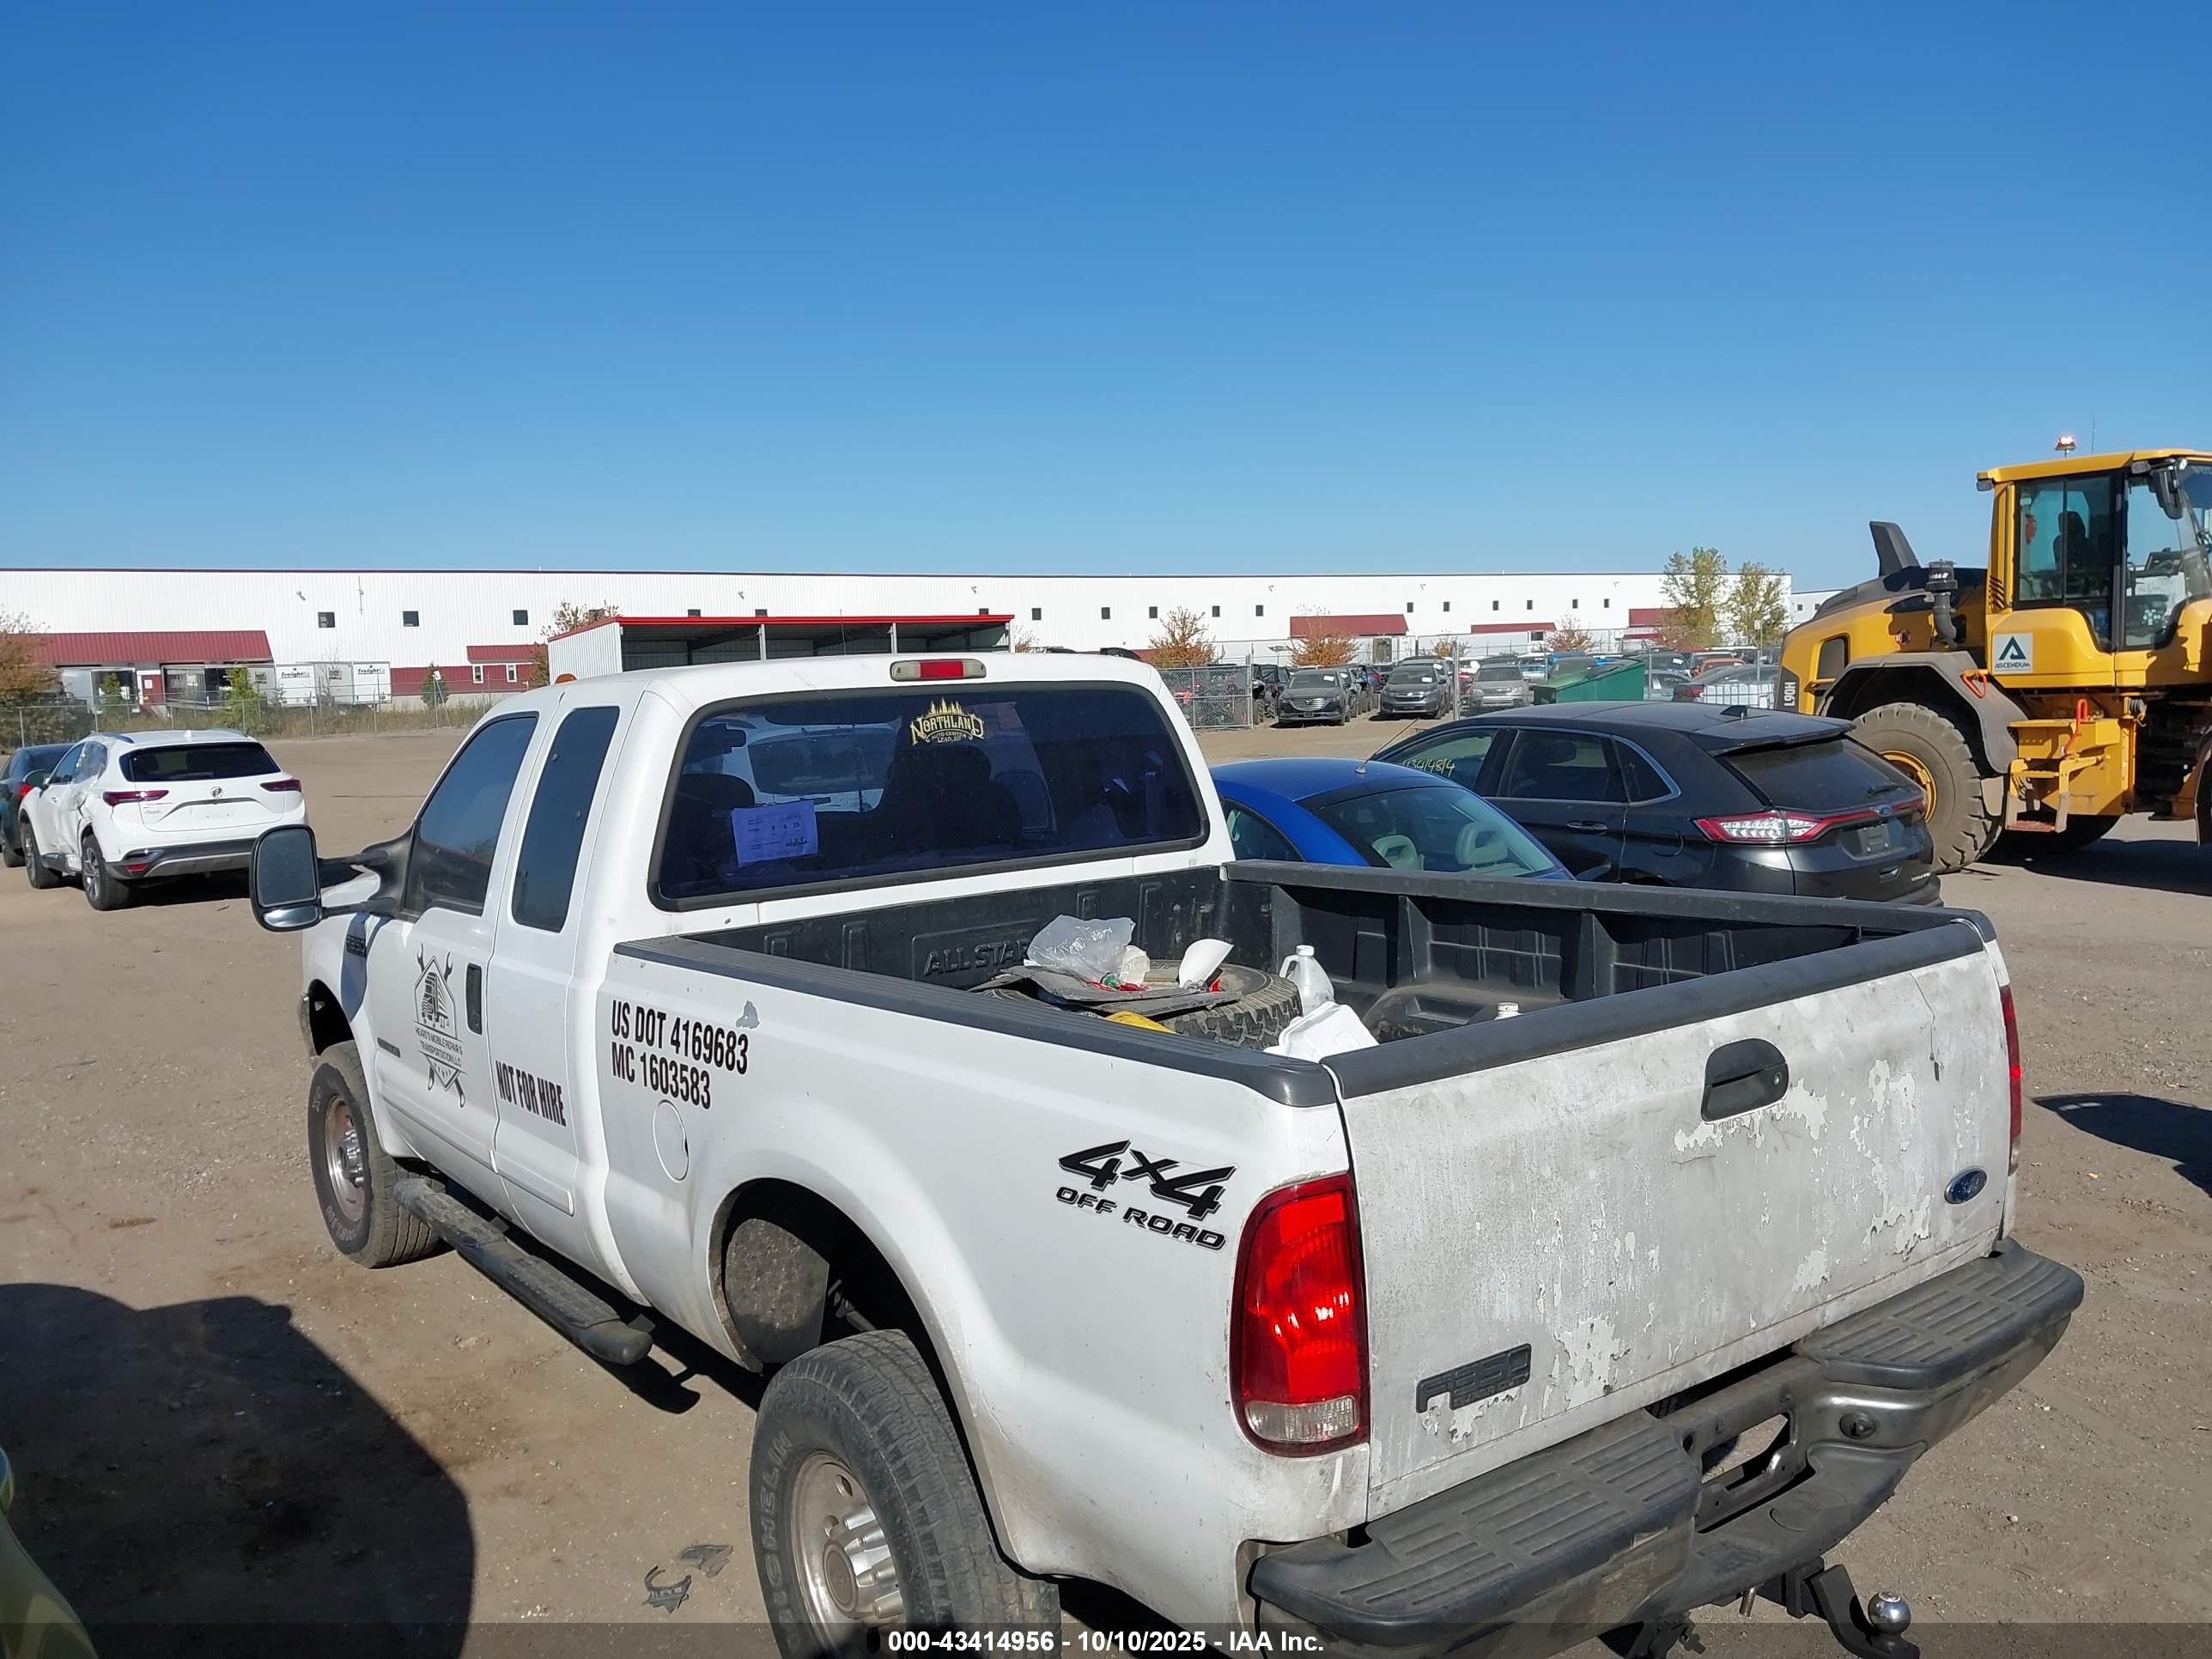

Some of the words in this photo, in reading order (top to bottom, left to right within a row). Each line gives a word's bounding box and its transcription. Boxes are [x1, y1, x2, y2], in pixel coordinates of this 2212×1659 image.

[1784, 681, 1796, 707] L90H
[910, 714, 985, 745] NORTHLAND
[931, 732, 945, 740] AUTO
[611, 999, 631, 1040] US
[635, 1006, 667, 1049] DOT
[670, 1016, 749, 1075] 4169683
[495, 1059, 518, 1107] NOT
[515, 1067, 540, 1116] FOR
[536, 1076, 567, 1127] HIRE
[611, 1041, 635, 1084] MC
[640, 1051, 711, 1110] 1603583
[1055, 1186, 1118, 1214] OFF
[1121, 1206, 1227, 1251] ROAD
